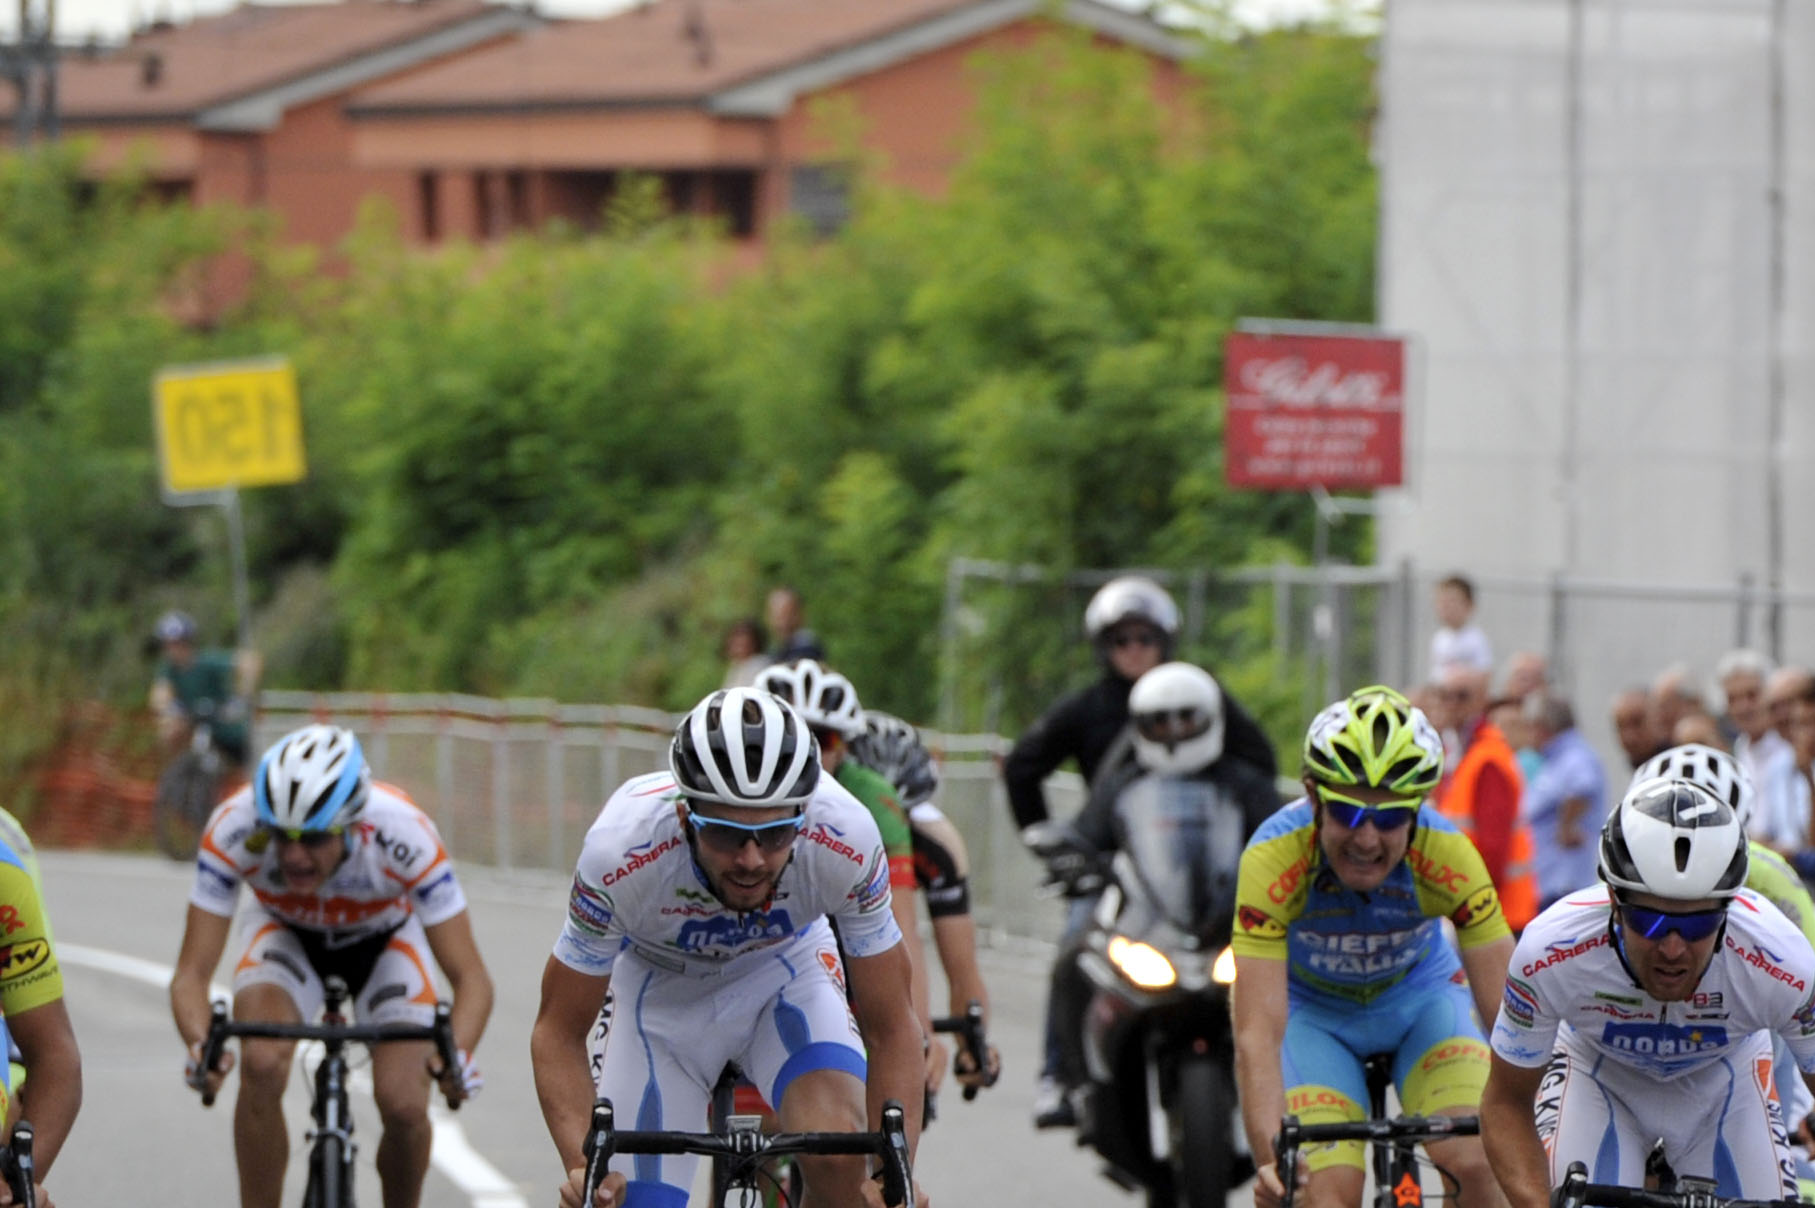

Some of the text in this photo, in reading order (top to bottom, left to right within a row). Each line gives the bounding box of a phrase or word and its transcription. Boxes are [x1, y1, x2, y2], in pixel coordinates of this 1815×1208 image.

[602, 836, 682, 887] CARRERA
[1523, 934, 1611, 977] CARRERA
[1725, 935, 1806, 993] CARRERA
